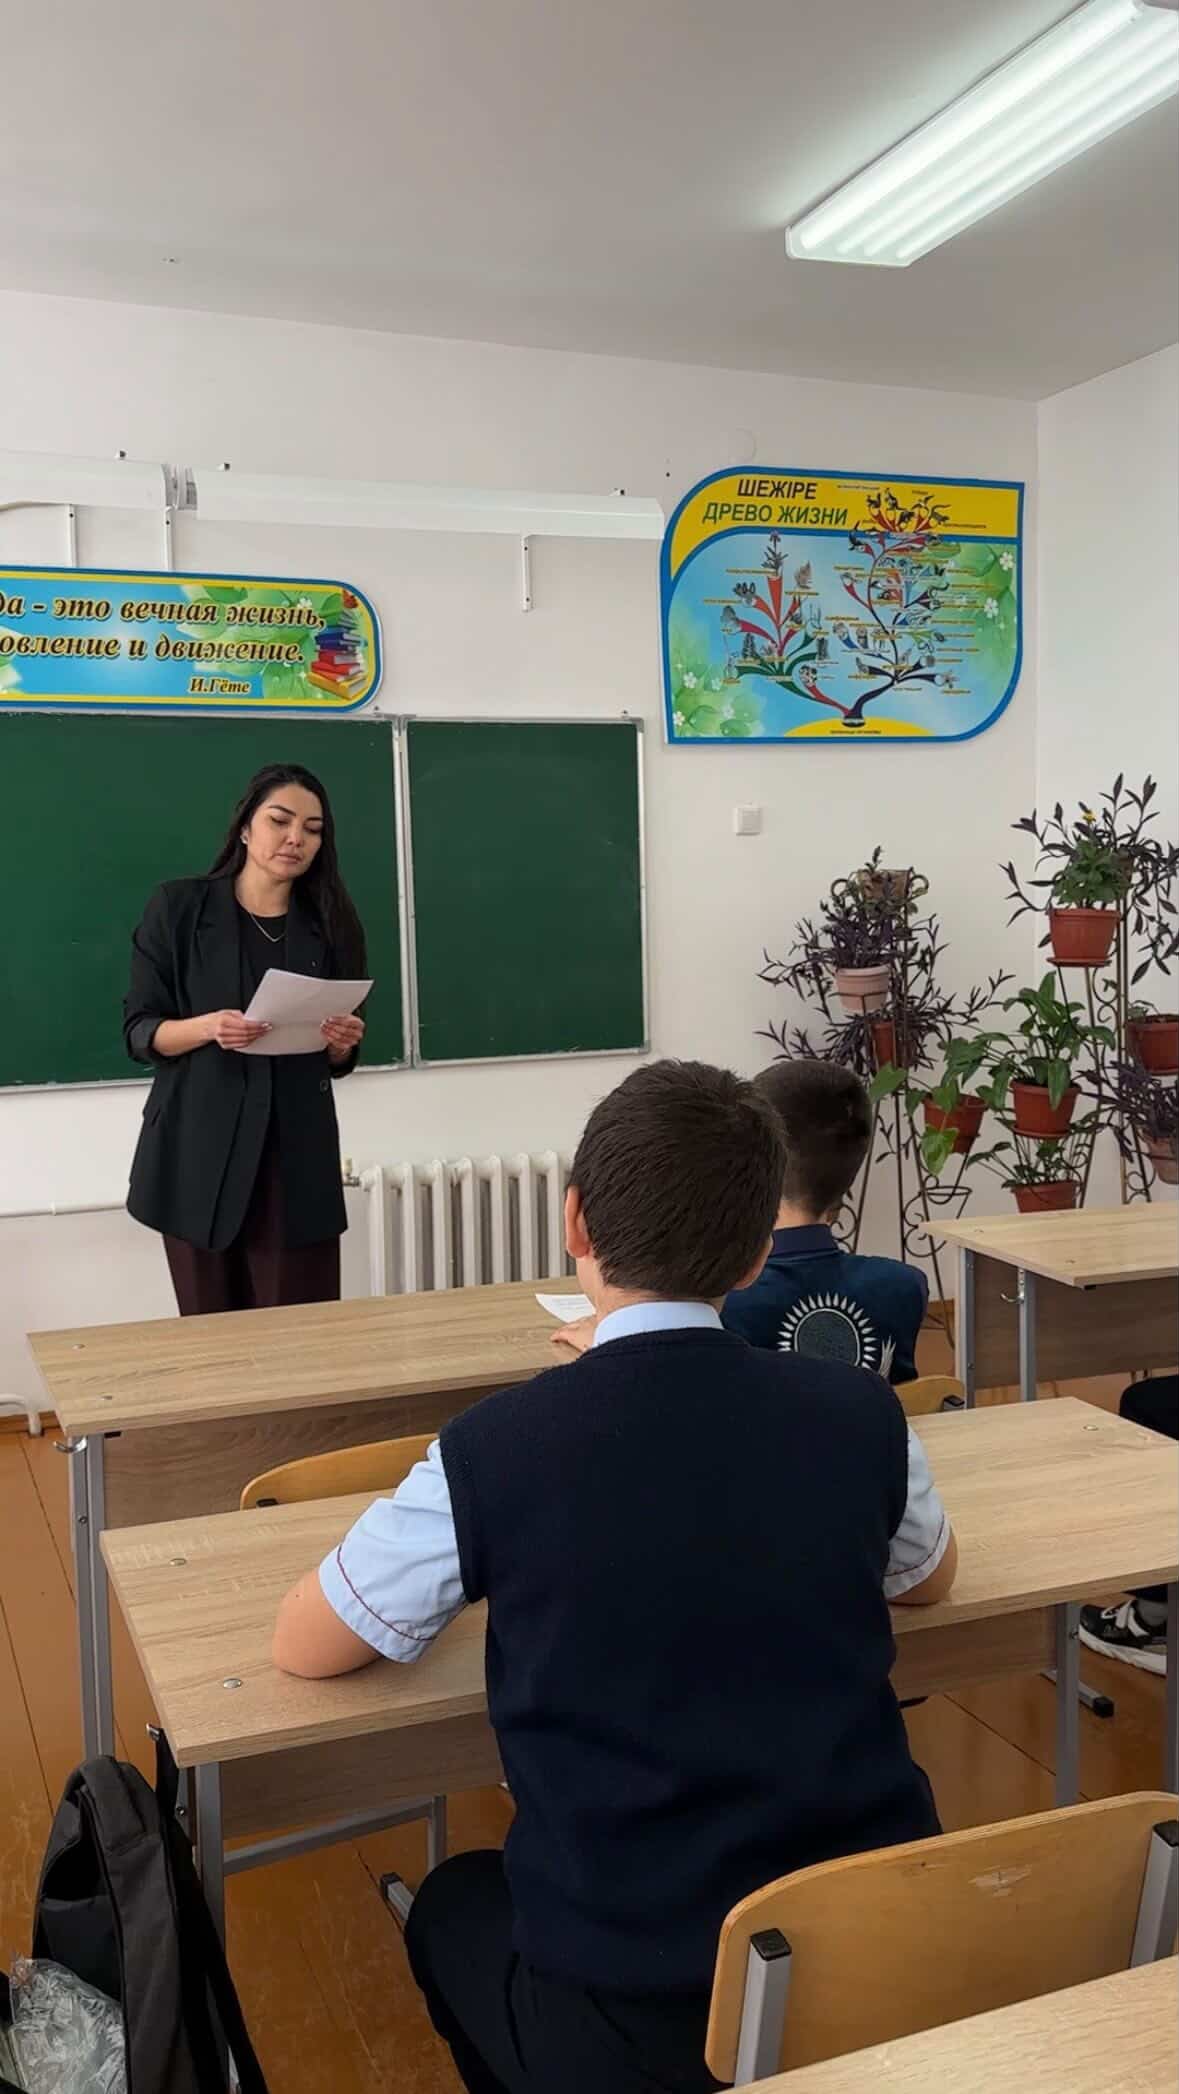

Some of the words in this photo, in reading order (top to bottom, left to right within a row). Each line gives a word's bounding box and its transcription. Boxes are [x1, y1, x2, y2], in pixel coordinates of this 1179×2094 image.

[737, 478, 817, 500] ШЕЖІРЕ
[702, 501, 773, 524] ДРЕВО
[777, 506, 848, 525] ЖИЗНИ
[53, 597, 111, 619] это
[120, 599, 217, 622] вечная
[226, 604, 326, 629] жизнь,
[0, 635, 120, 656] овление
[128, 637, 147, 657] и
[154, 634, 304, 662] движение.
[190, 677, 251, 695] И.Гёте
